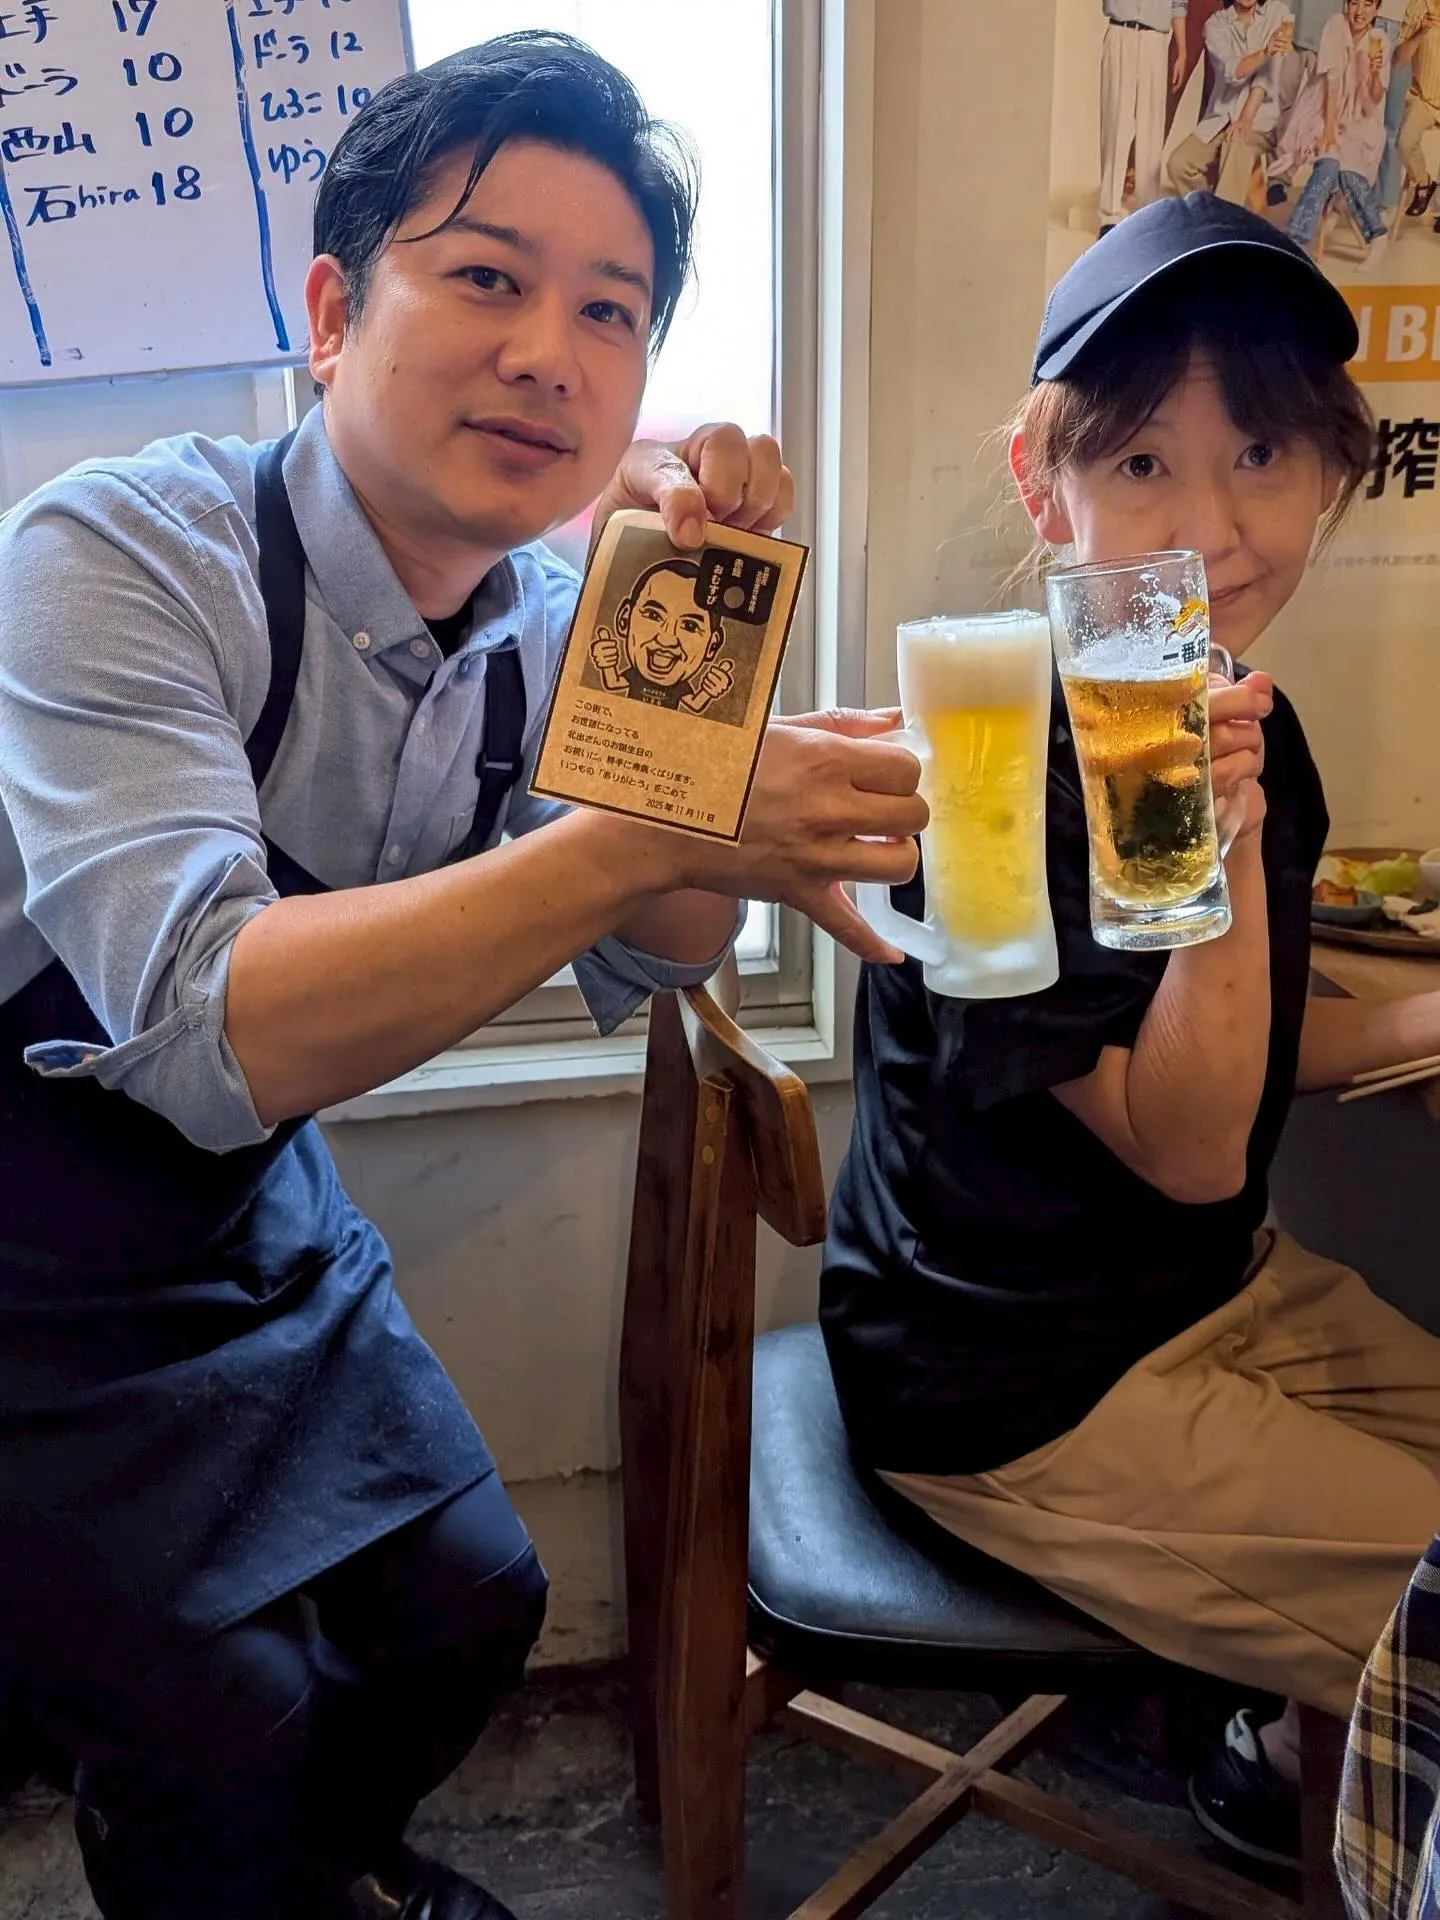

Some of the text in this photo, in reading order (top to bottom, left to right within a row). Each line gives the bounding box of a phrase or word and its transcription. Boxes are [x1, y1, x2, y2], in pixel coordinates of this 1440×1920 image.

[331, 31, 363, 59] 12
[123, 52, 182, 86] 10
[338, 84, 371, 115] 10
[136, 107, 194, 147] 10
[152, 165, 201, 205] 18
[1386, 304, 1440, 362] B
[706, 564, 724, 605] おむすび
[571, 714, 639, 740] お世話になってる
